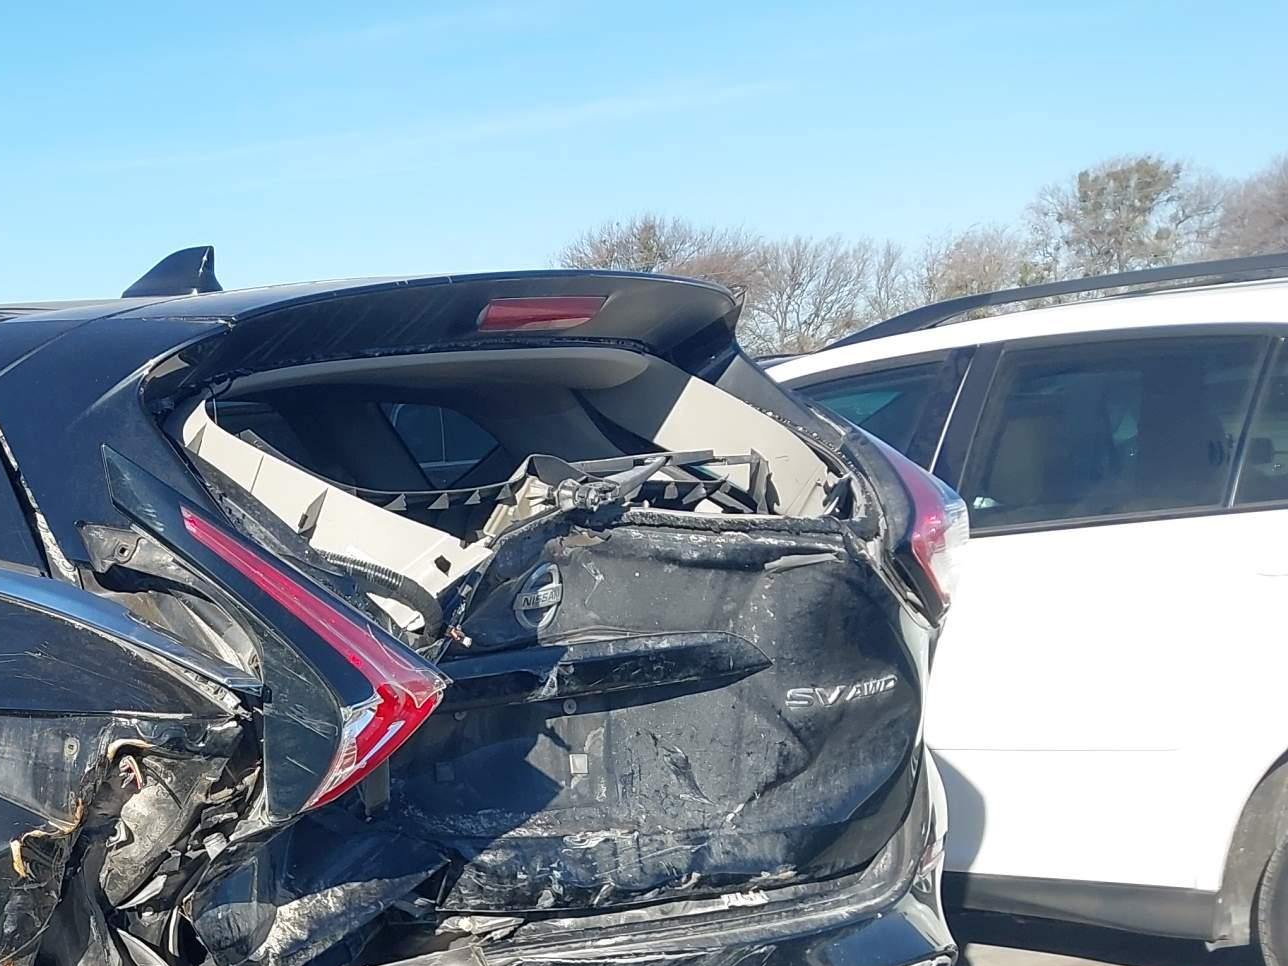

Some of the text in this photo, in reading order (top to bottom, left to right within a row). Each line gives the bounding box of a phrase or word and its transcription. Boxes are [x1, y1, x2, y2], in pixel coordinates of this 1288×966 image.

[521, 590, 560, 608] NISSAN
[785, 674, 898, 710] SV AWD
